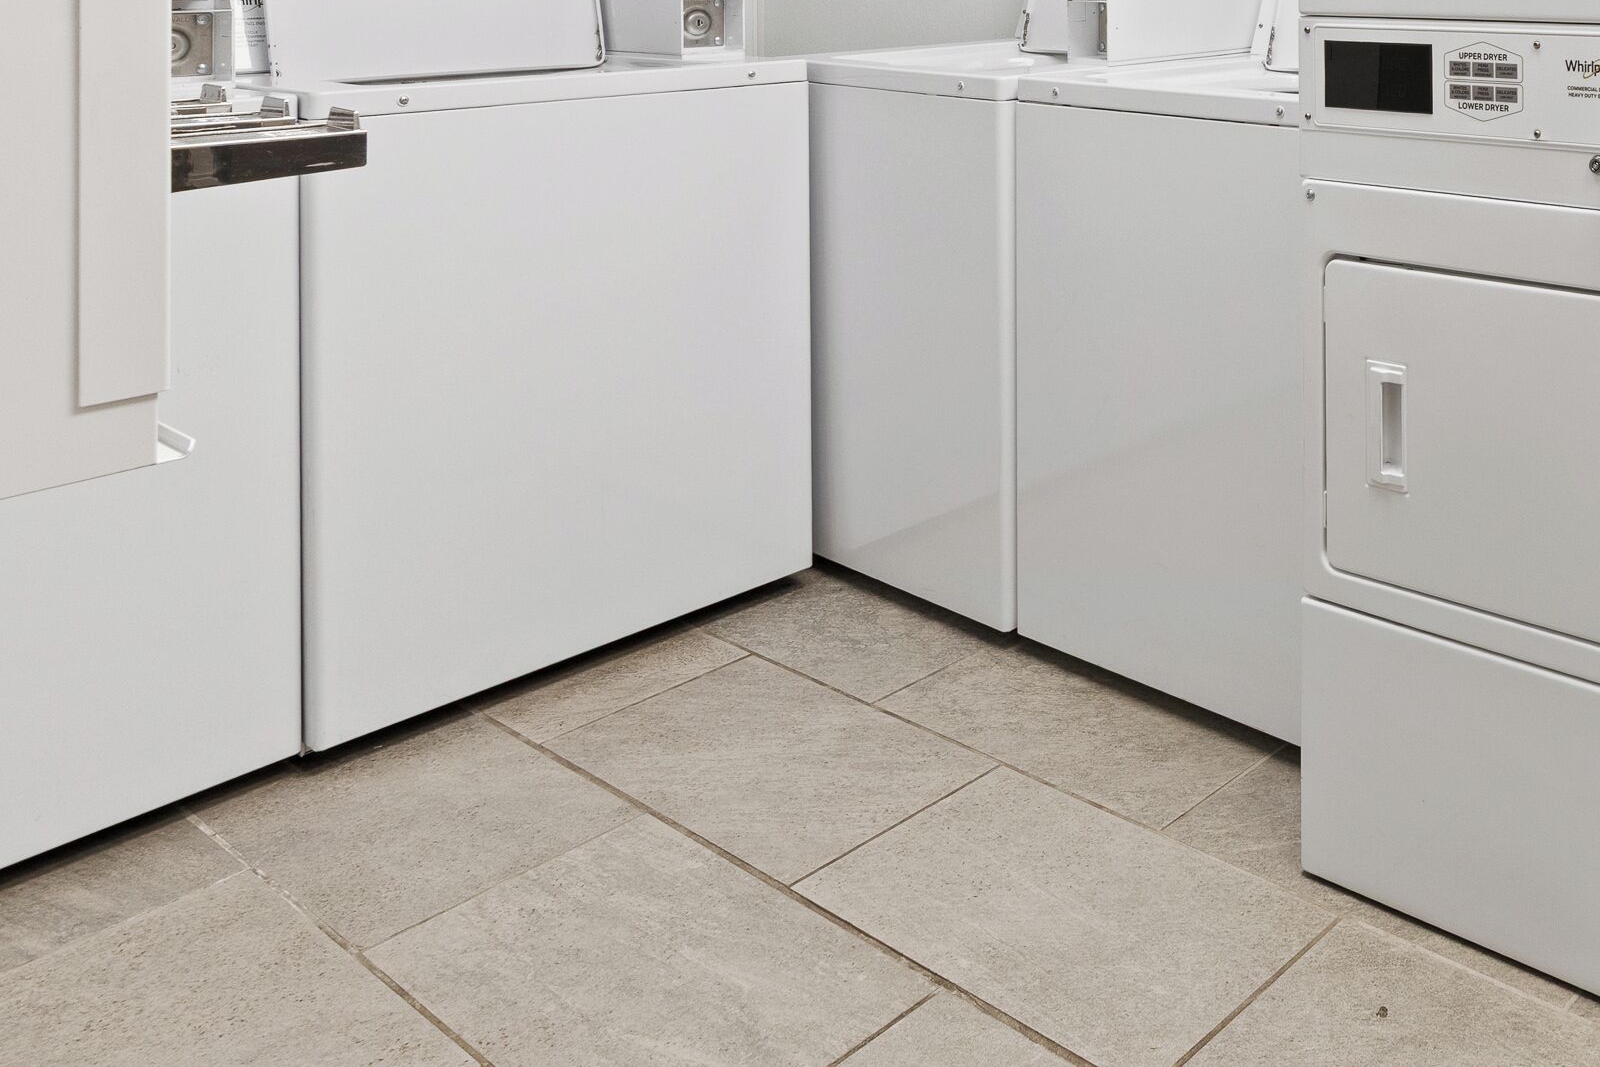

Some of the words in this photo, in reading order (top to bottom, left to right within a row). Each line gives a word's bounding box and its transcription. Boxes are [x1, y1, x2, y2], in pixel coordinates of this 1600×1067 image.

[1483, 53, 1508, 61] DRYER
[1458, 102, 1483, 110] LOWER
[1485, 104, 1509, 112] DRYER
